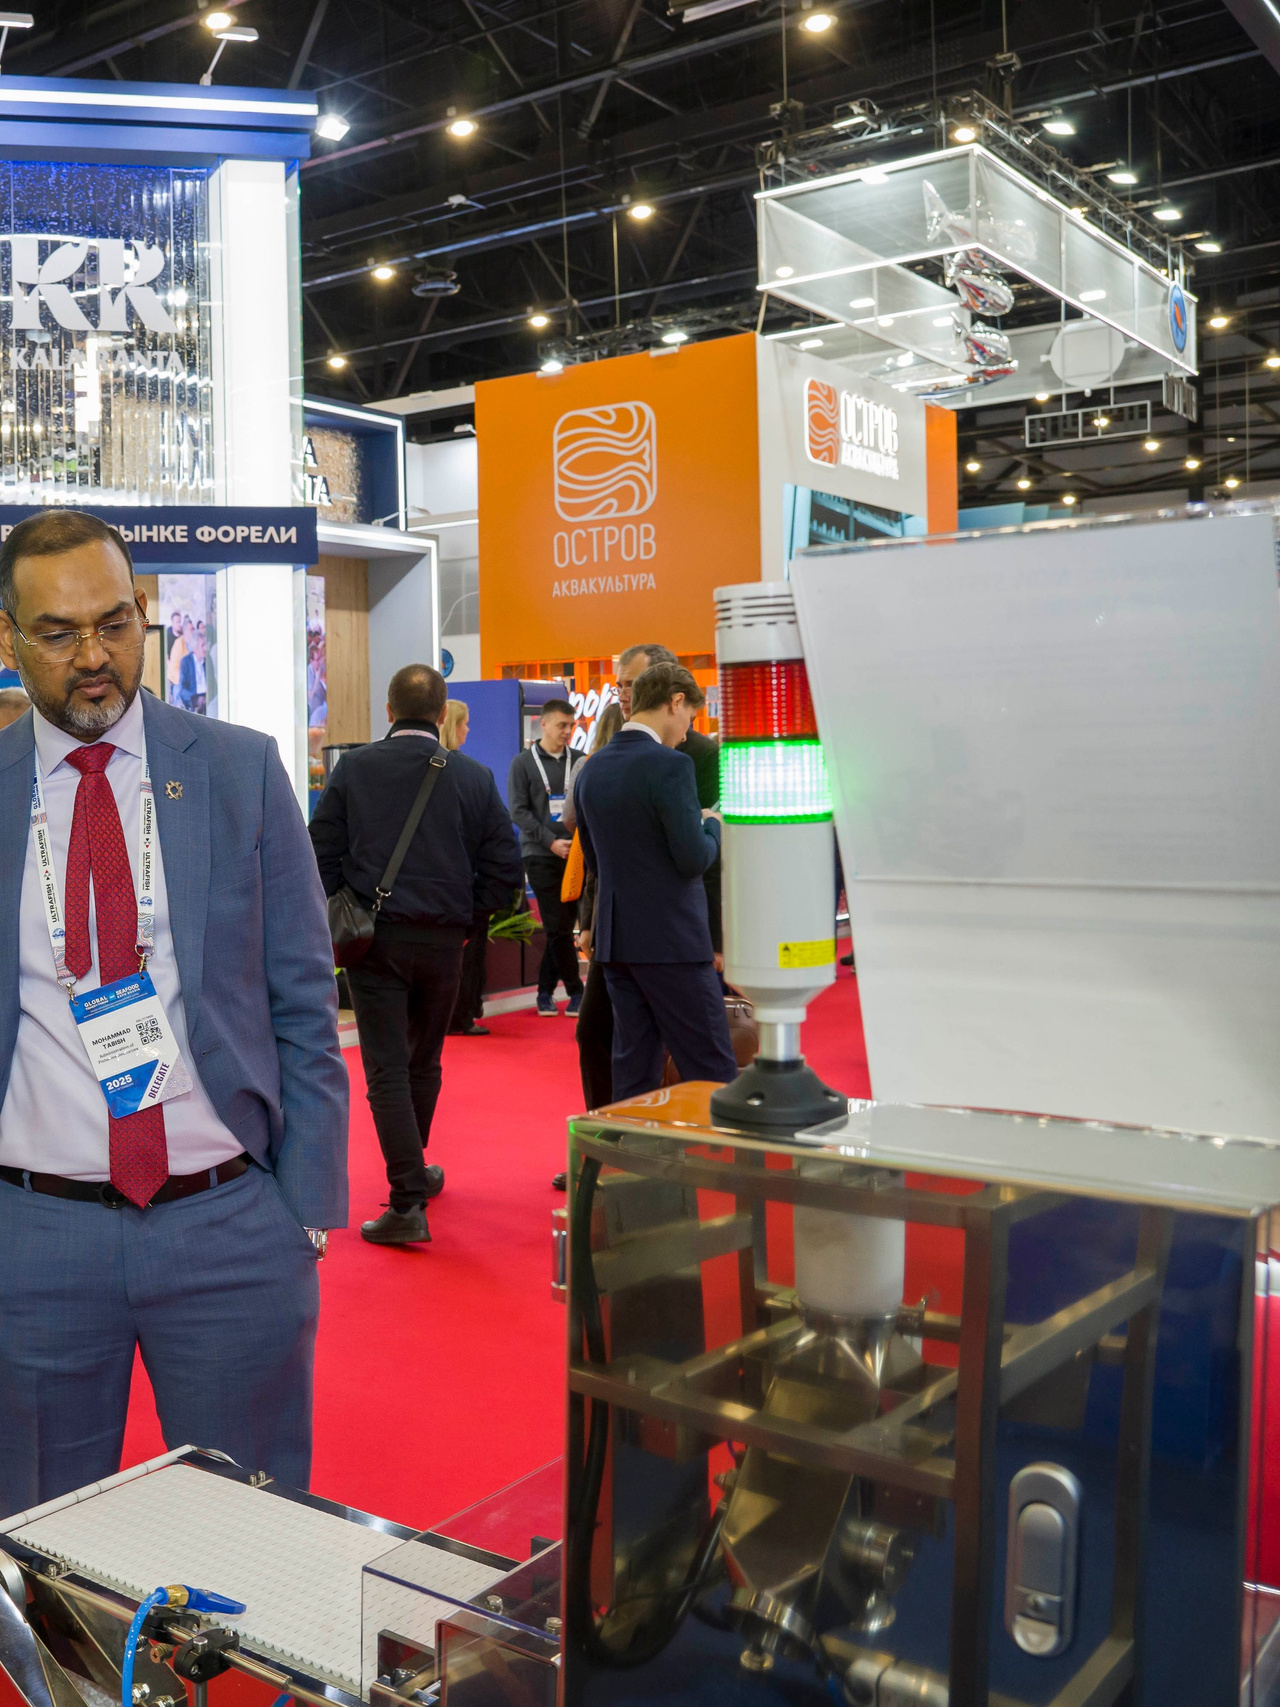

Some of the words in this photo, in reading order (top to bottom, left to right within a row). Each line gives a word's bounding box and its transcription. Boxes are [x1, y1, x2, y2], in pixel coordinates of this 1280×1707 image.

[840, 390, 899, 456] ОСТРОВ
[108, 524, 189, 543] ЫНКЕ
[195, 525, 298, 544] ФОРЕЛИ
[553, 523, 657, 568] ОСТРОВ
[552, 573, 657, 598] АКВАКУЛЬТУРА
[37, 829, 48, 867] ULTRAFISH
[46, 883, 57, 923] ULTRAFISH
[115, 983, 140, 995] SEAFOOD
[84, 996, 108, 1008] GLOBAL
[92, 1027, 131, 1046] MOHAMMAD
[103, 1037, 126, 1050] TABISH
[106, 1074, 133, 1091] 2025
[148, 1062, 170, 1099] DELEGATE
